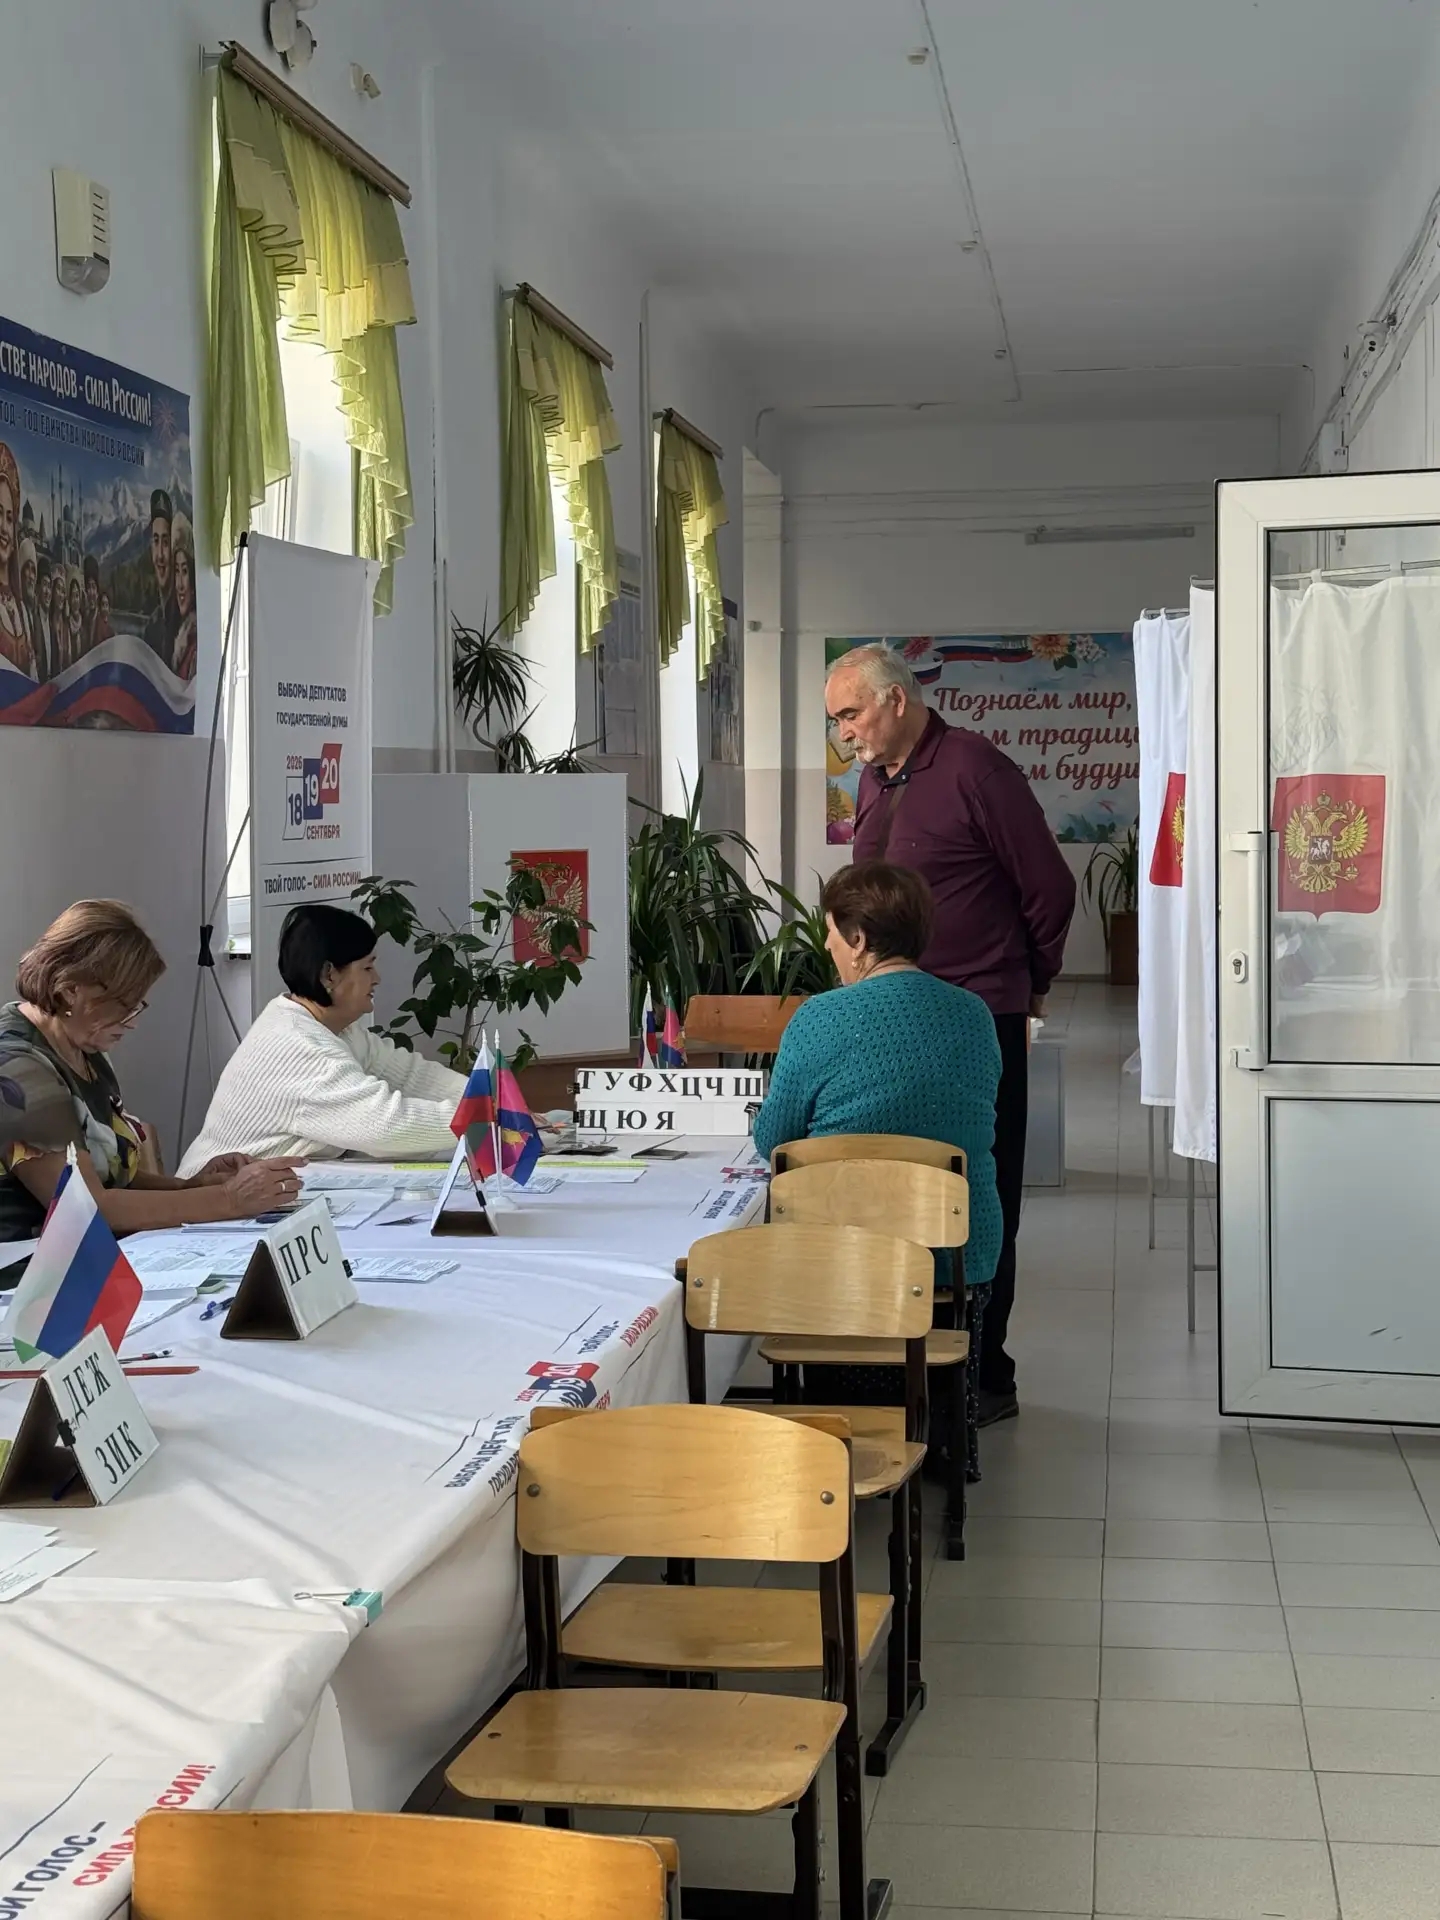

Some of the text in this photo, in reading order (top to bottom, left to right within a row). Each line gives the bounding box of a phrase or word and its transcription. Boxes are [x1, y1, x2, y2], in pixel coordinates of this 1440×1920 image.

[0, 341, 27, 379] СТВЕ
[29, 352, 77, 398] НАРОДОВ
[85, 374, 111, 411] СИЛА
[41, 413, 79, 444] ЕДИНСТВА
[81, 427, 115, 457] НАРОДОВ
[117, 440, 145, 467] РОССИИ
[278, 682, 346, 702] ВЫБОРЫ ДЕПУТАТОВ
[933, 687, 1131, 721] Познаём мир,
[277, 711, 348, 729] ГОСУДАРСТВЕННОЙ ДУМЫ
[286, 755, 303, 770] 2026
[321, 757, 338, 789] 20
[305, 774, 319, 806] 19
[288, 793, 303, 826] 18
[306, 825, 340, 839] СЕНТЯБРЯ
[264, 874, 282, 894] ТВОЙ
[283, 876, 306, 892] ГОЛОС
[313, 873, 331, 889] СИЛА
[278, 1225, 329, 1286] ПРС
[542, 1364, 582, 1377] 20
[62, 1352, 111, 1426] ДЕЖ
[95, 1421, 142, 1484] ЗИК
[72, 1763, 217, 1887] СИЛА СИИ!
[12, 1835, 97, 1892] ГОЛОС
